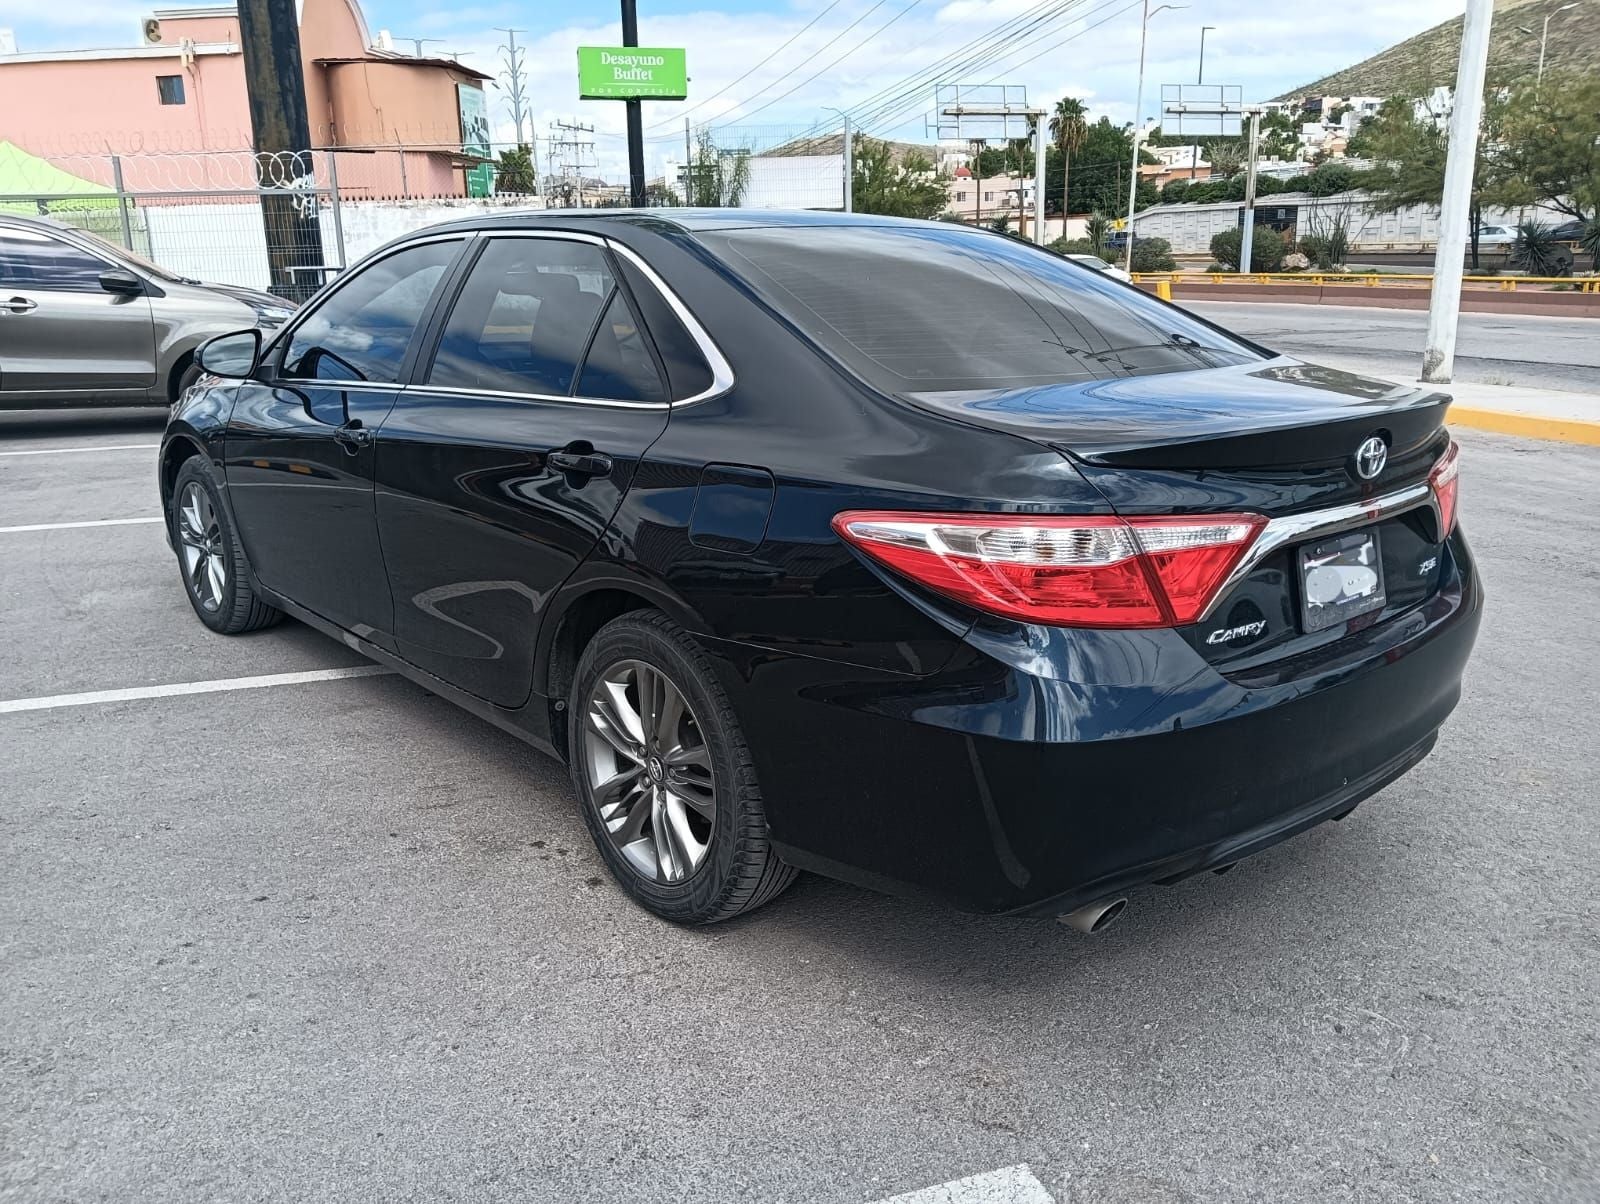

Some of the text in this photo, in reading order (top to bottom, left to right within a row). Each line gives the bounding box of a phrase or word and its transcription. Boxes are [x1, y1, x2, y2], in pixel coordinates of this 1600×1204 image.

[601, 52, 664, 67] Desayuno
[614, 67, 653, 80] Buffet
[1206, 619, 1267, 645] CAMRY
